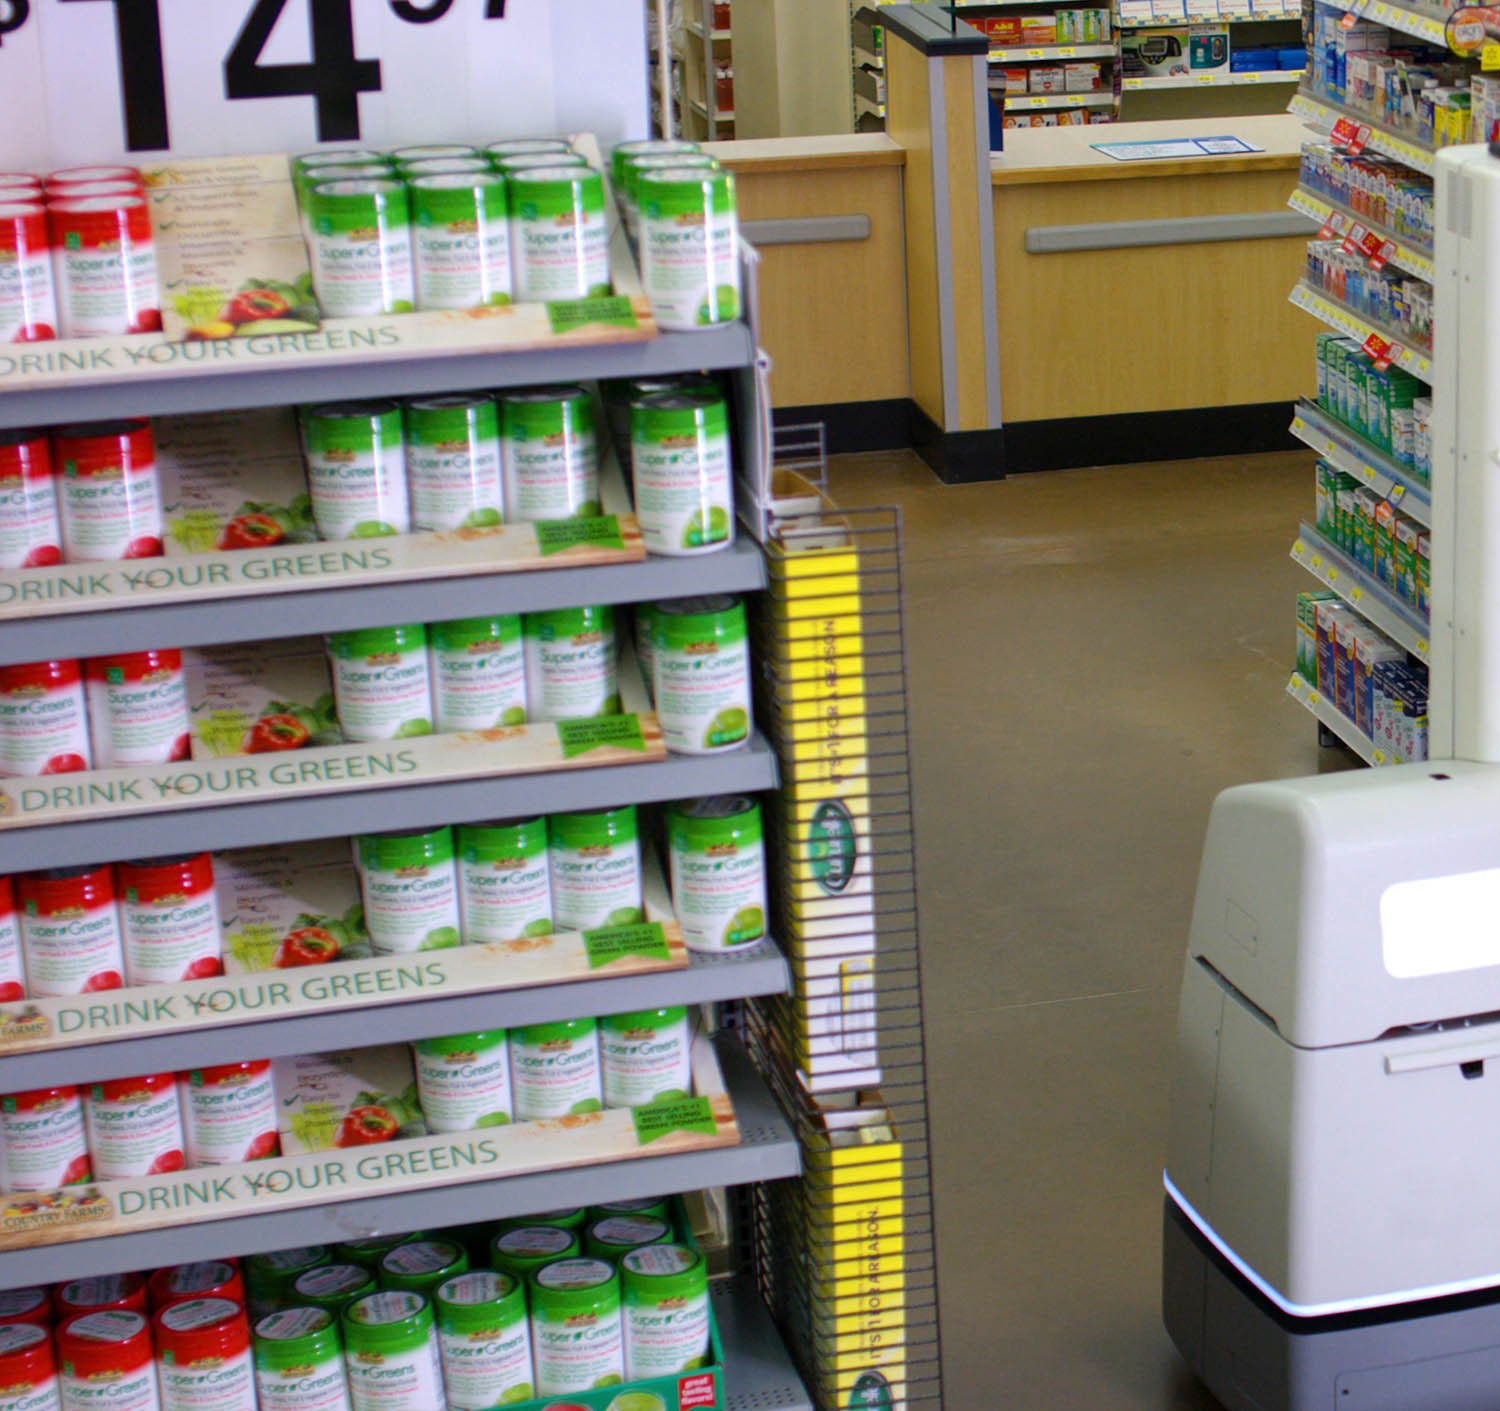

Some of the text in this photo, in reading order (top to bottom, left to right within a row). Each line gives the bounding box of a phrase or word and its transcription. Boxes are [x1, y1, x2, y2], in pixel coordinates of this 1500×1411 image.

[417, 231, 504, 250] Super Geens
[522, 225, 606, 246] Super Geens
[686, 226, 731, 243] Geens
[363, 238, 408, 257] Geens
[66, 256, 107, 271] Super
[122, 338, 241, 366] YOUR
[245, 323, 400, 353] GREENS
[409, 452, 495, 469] Super Geens
[514, 448, 597, 465] Super Geens
[683, 450, 723, 465] Geens
[337, 463, 387, 478] Grees
[64, 479, 153, 502] Super Grens
[121, 562, 240, 590] YOUR
[241, 547, 392, 580] GREENS
[439, 656, 475, 672] Super
[540, 649, 575, 664] Super
[661, 656, 693, 672] Super
[339, 668, 373, 683] Super
[108, 682, 186, 704] Super Gree
[21, 748, 417, 812] DRINK YOUR GREENS
[553, 859, 586, 875] Super
[680, 860, 712, 875] Super
[368, 878, 399, 895] Super
[466, 873, 500, 888] Super
[128, 911, 161, 927] Super
[27, 922, 60, 937] Super
[57, 962, 448, 1033] DRINK YOUR GREENS
[517, 1055, 547, 1070] Super
[420, 1066, 452, 1081] Super
[194, 1093, 227, 1108] Super
[94, 1109, 128, 1124] Super
[2, 1118, 42, 1133] Super
[118, 1139, 499, 1216] DRINK YOUR GREENS
[3, 1205, 106, 1228] COUNTRY FARMS
[630, 1313, 665, 1328] Super
[540, 1330, 572, 1345] Super
[165, 1374, 198, 1388] Super
[684, 1377, 708, 1390] great
[682, 1386, 712, 1397] tasting
